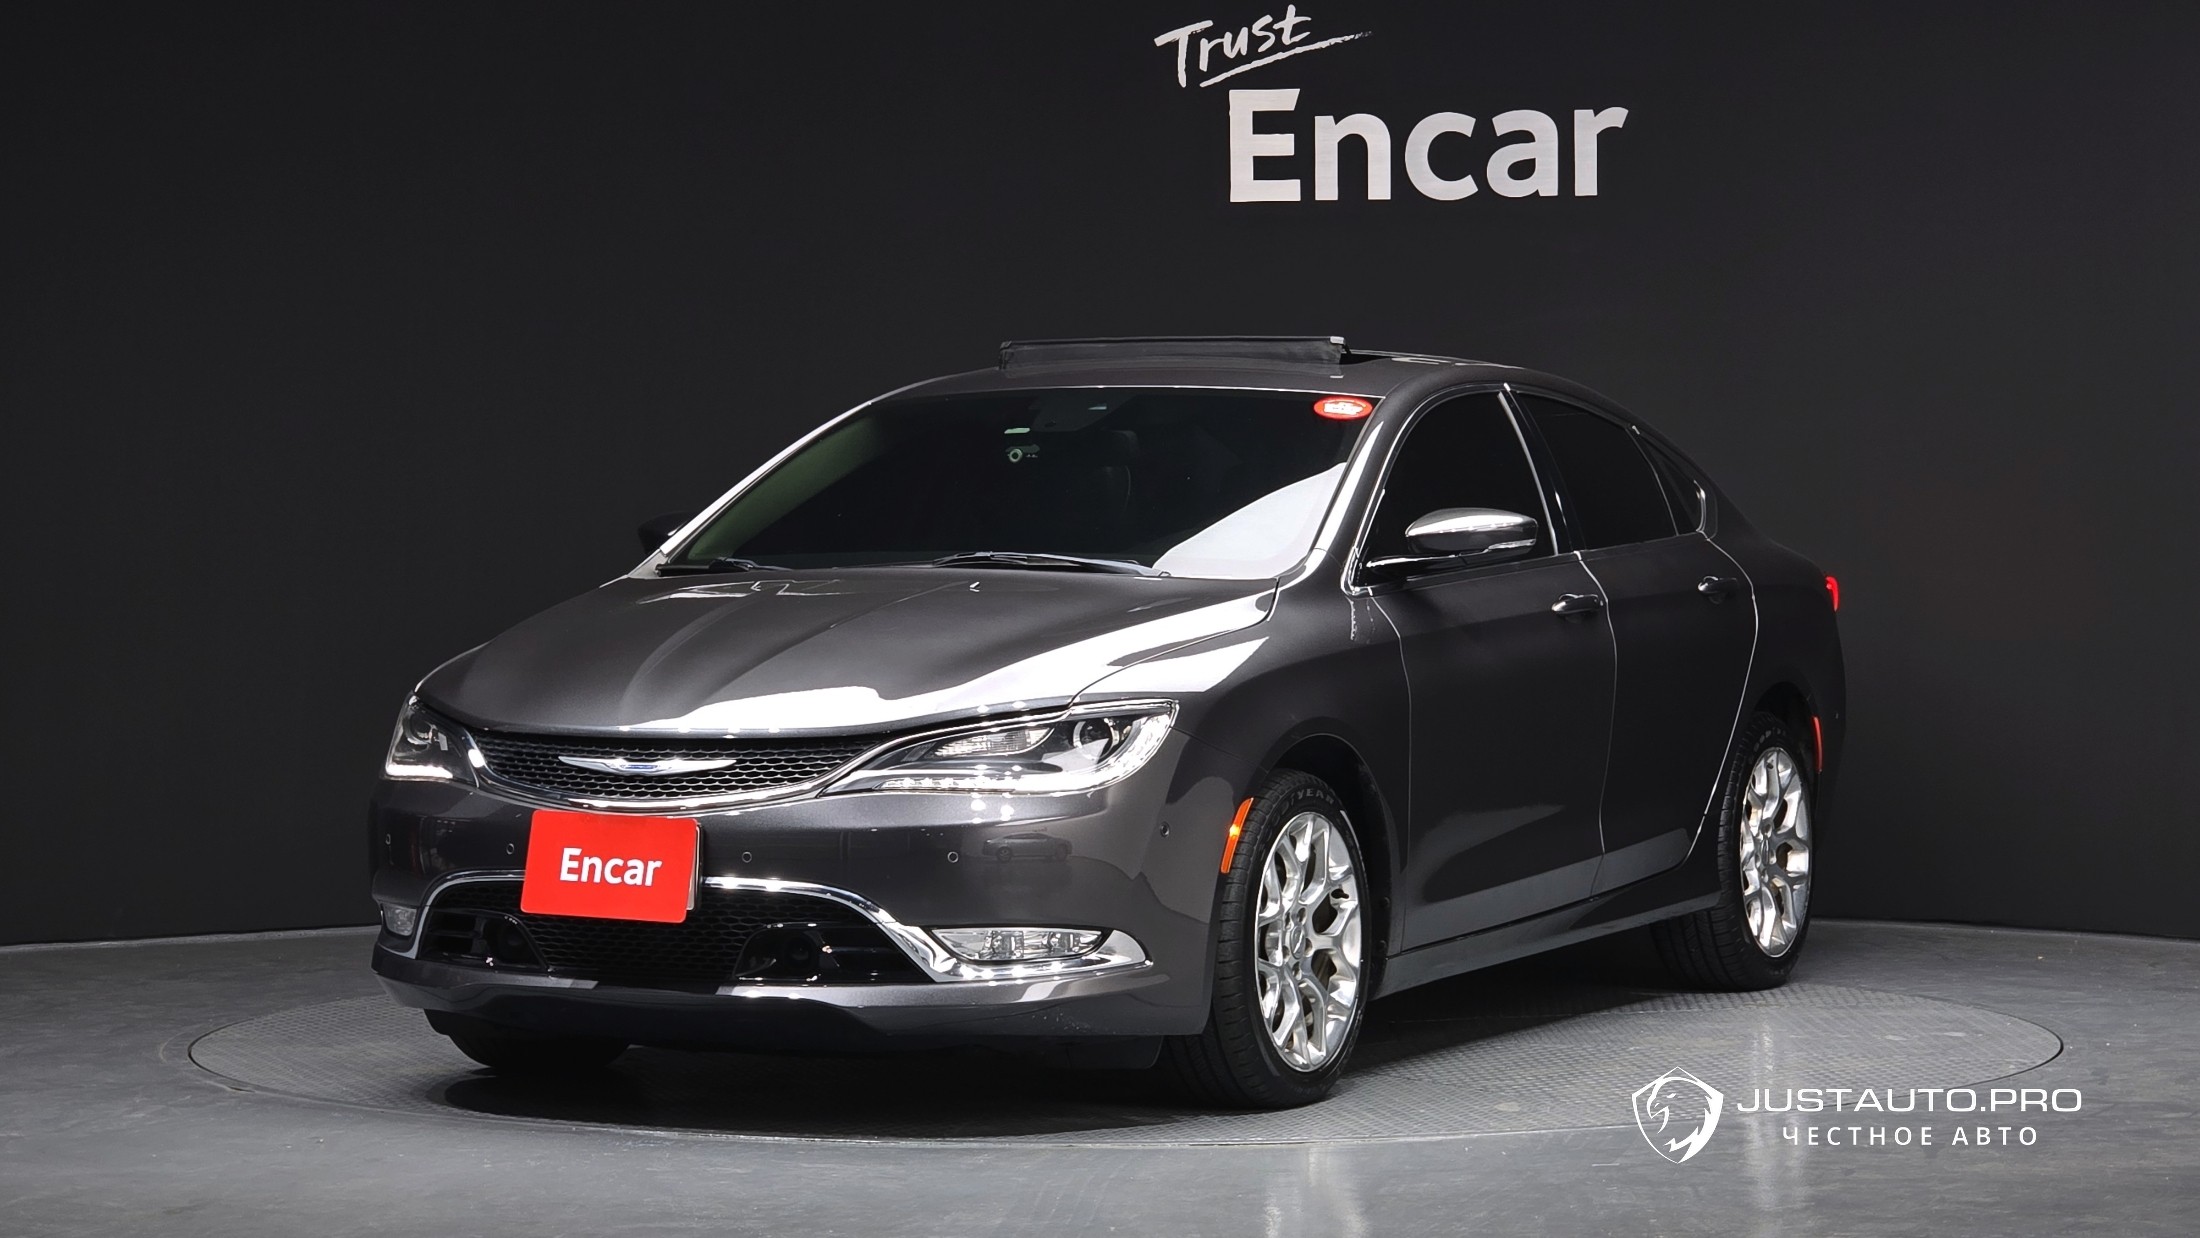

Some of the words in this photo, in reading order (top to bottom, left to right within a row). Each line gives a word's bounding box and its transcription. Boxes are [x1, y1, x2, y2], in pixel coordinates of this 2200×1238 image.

[1153, 4, 1312, 88] Trust
[1228, 88, 1629, 203] Encar
[559, 846, 663, 887] Encar
